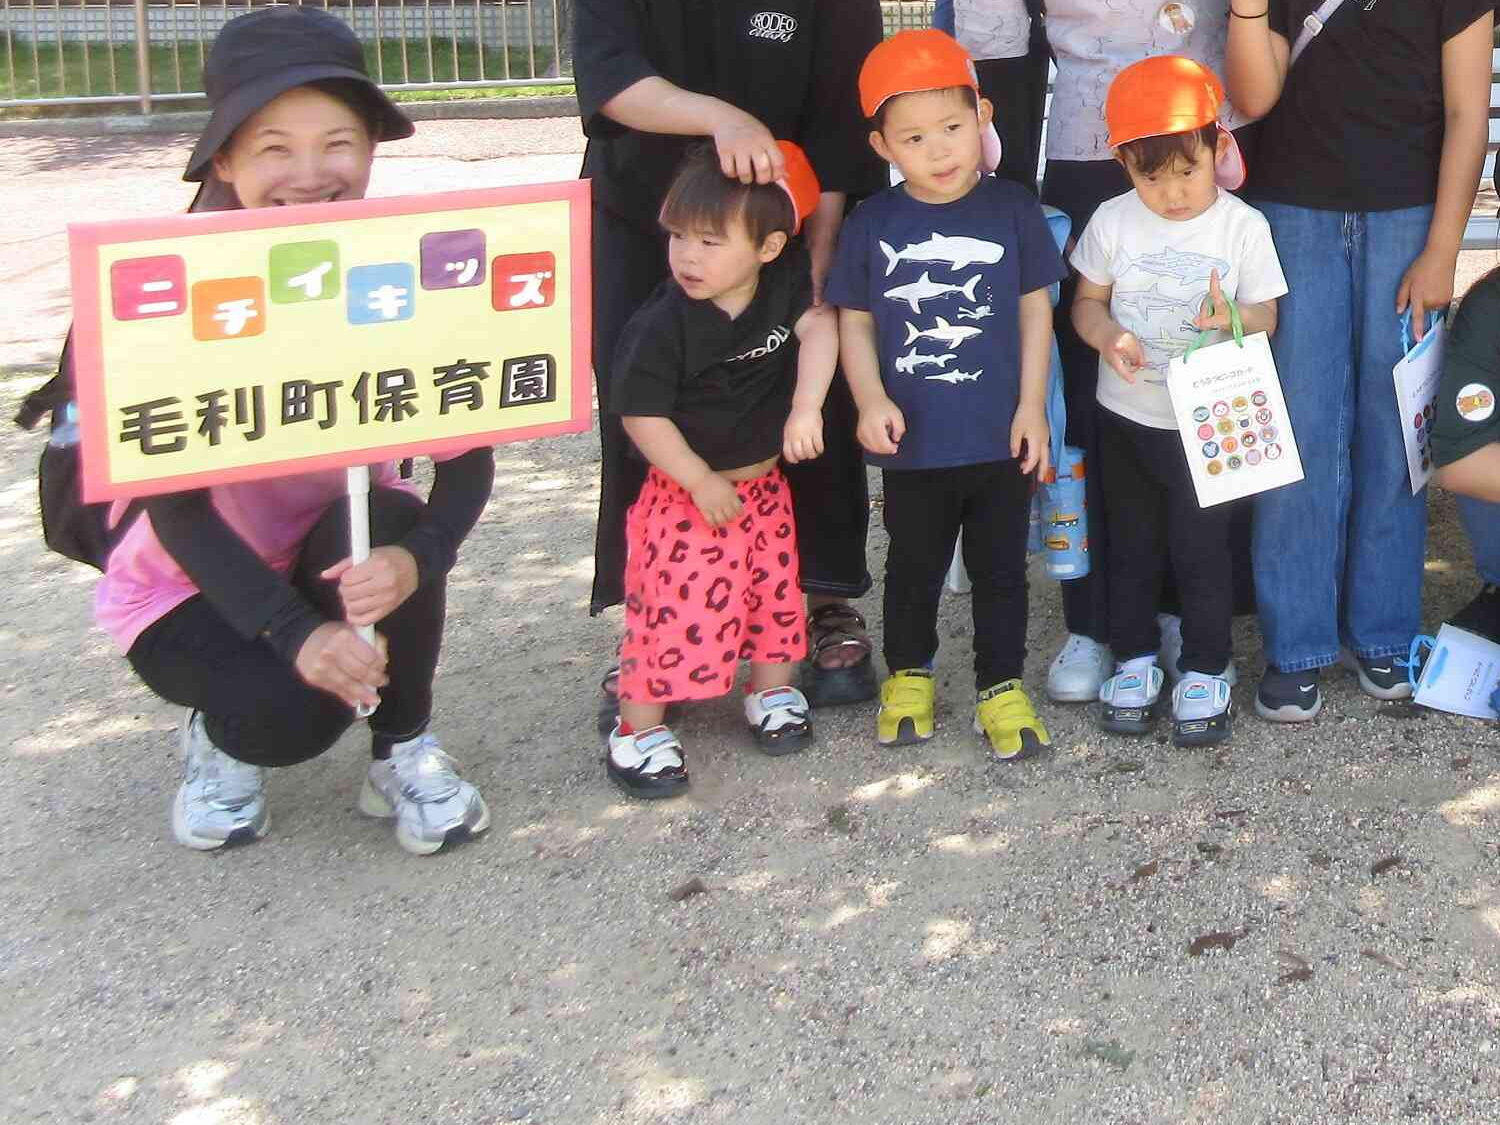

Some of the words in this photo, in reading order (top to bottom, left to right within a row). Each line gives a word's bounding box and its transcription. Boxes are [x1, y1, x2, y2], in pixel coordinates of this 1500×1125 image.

[754, 14, 794, 32] RODEO
[136, 258, 553, 336] ニチイキッズ
[119, 353, 557, 456] 毛利町保育園
